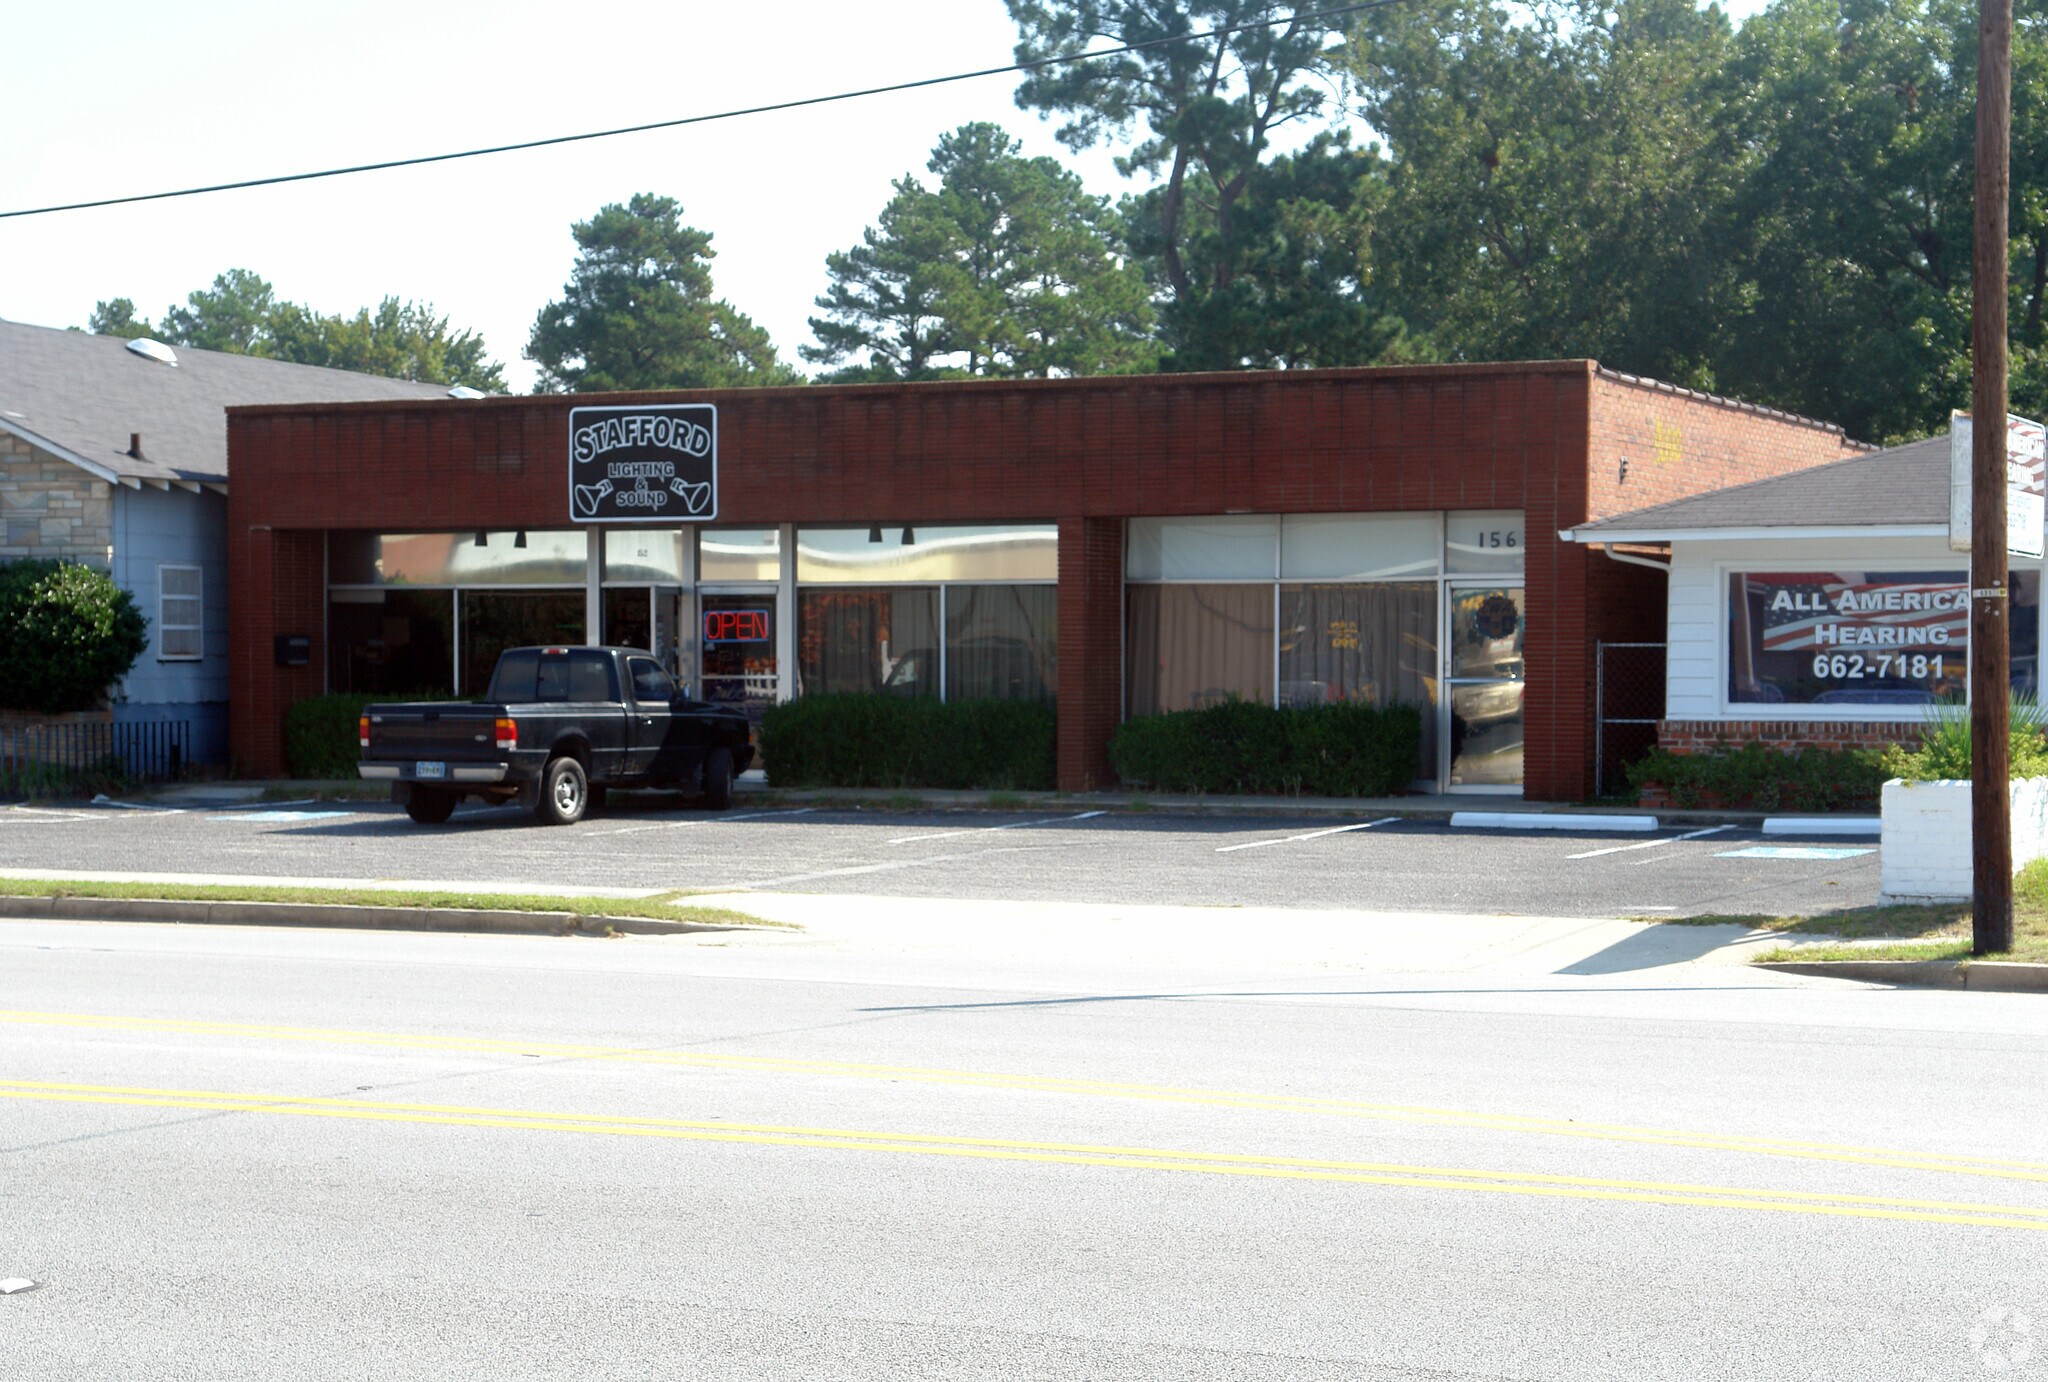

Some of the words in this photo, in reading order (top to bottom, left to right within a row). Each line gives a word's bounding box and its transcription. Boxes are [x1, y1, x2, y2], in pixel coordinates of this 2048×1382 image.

[574, 416, 711, 463] STAFFORD
[608, 461, 674, 483] LIGHTING
[635, 477, 648, 491] &
[616, 490, 668, 512] SOUND
[1479, 532, 1516, 548] 156
[1771, 590, 1827, 611] ALL
[1837, 590, 1970, 611] AMERICA
[705, 611, 768, 640] OPEN
[1815, 624, 1949, 645] HEARING
[1813, 655, 1943, 679] 662-7181
